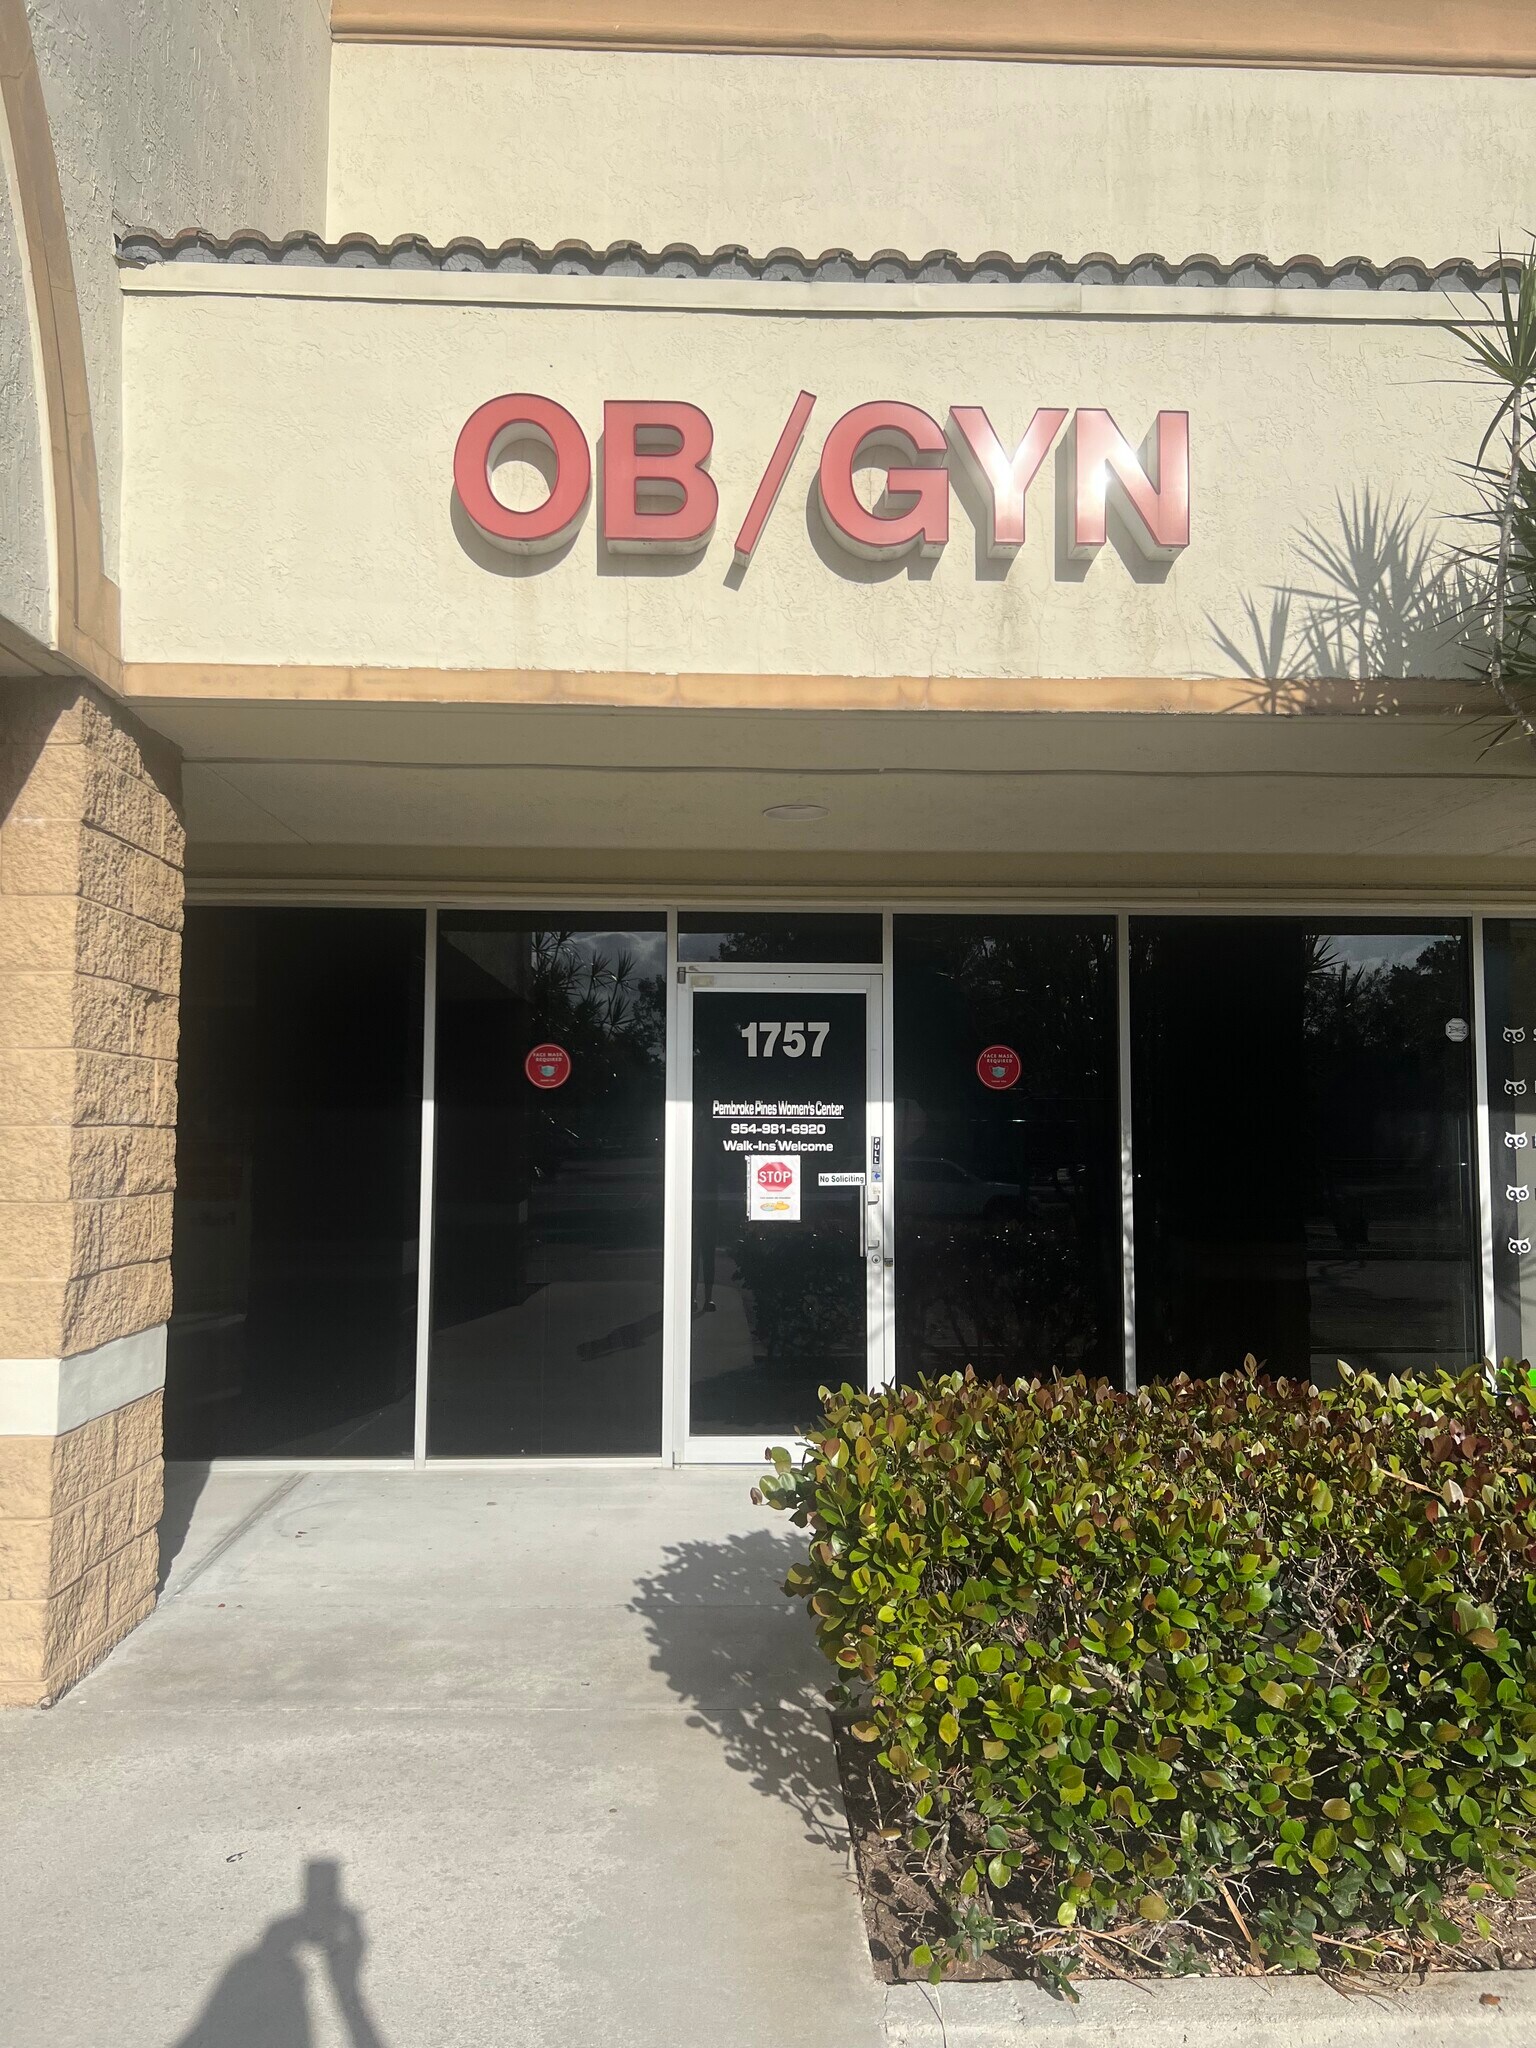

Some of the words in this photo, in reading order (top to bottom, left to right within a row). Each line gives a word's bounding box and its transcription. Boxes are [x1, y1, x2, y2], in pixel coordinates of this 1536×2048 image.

[453, 390, 1191, 554] OB/GYN
[741, 1022, 830, 1058] 1757
[712, 1100, 754, 1115] Pembroke
[755, 1100, 777, 1116] Pines
[778, 1100, 815, 1116] Women's
[815, 1101, 844, 1116] Center
[730, 1123, 826, 1135] 954-981-6920
[778, 1140, 834, 1152] Welcome
[758, 1170, 791, 1183] STOP
[819, 1175, 830, 1183] No
[831, 1174, 865, 1184] Soliciting
